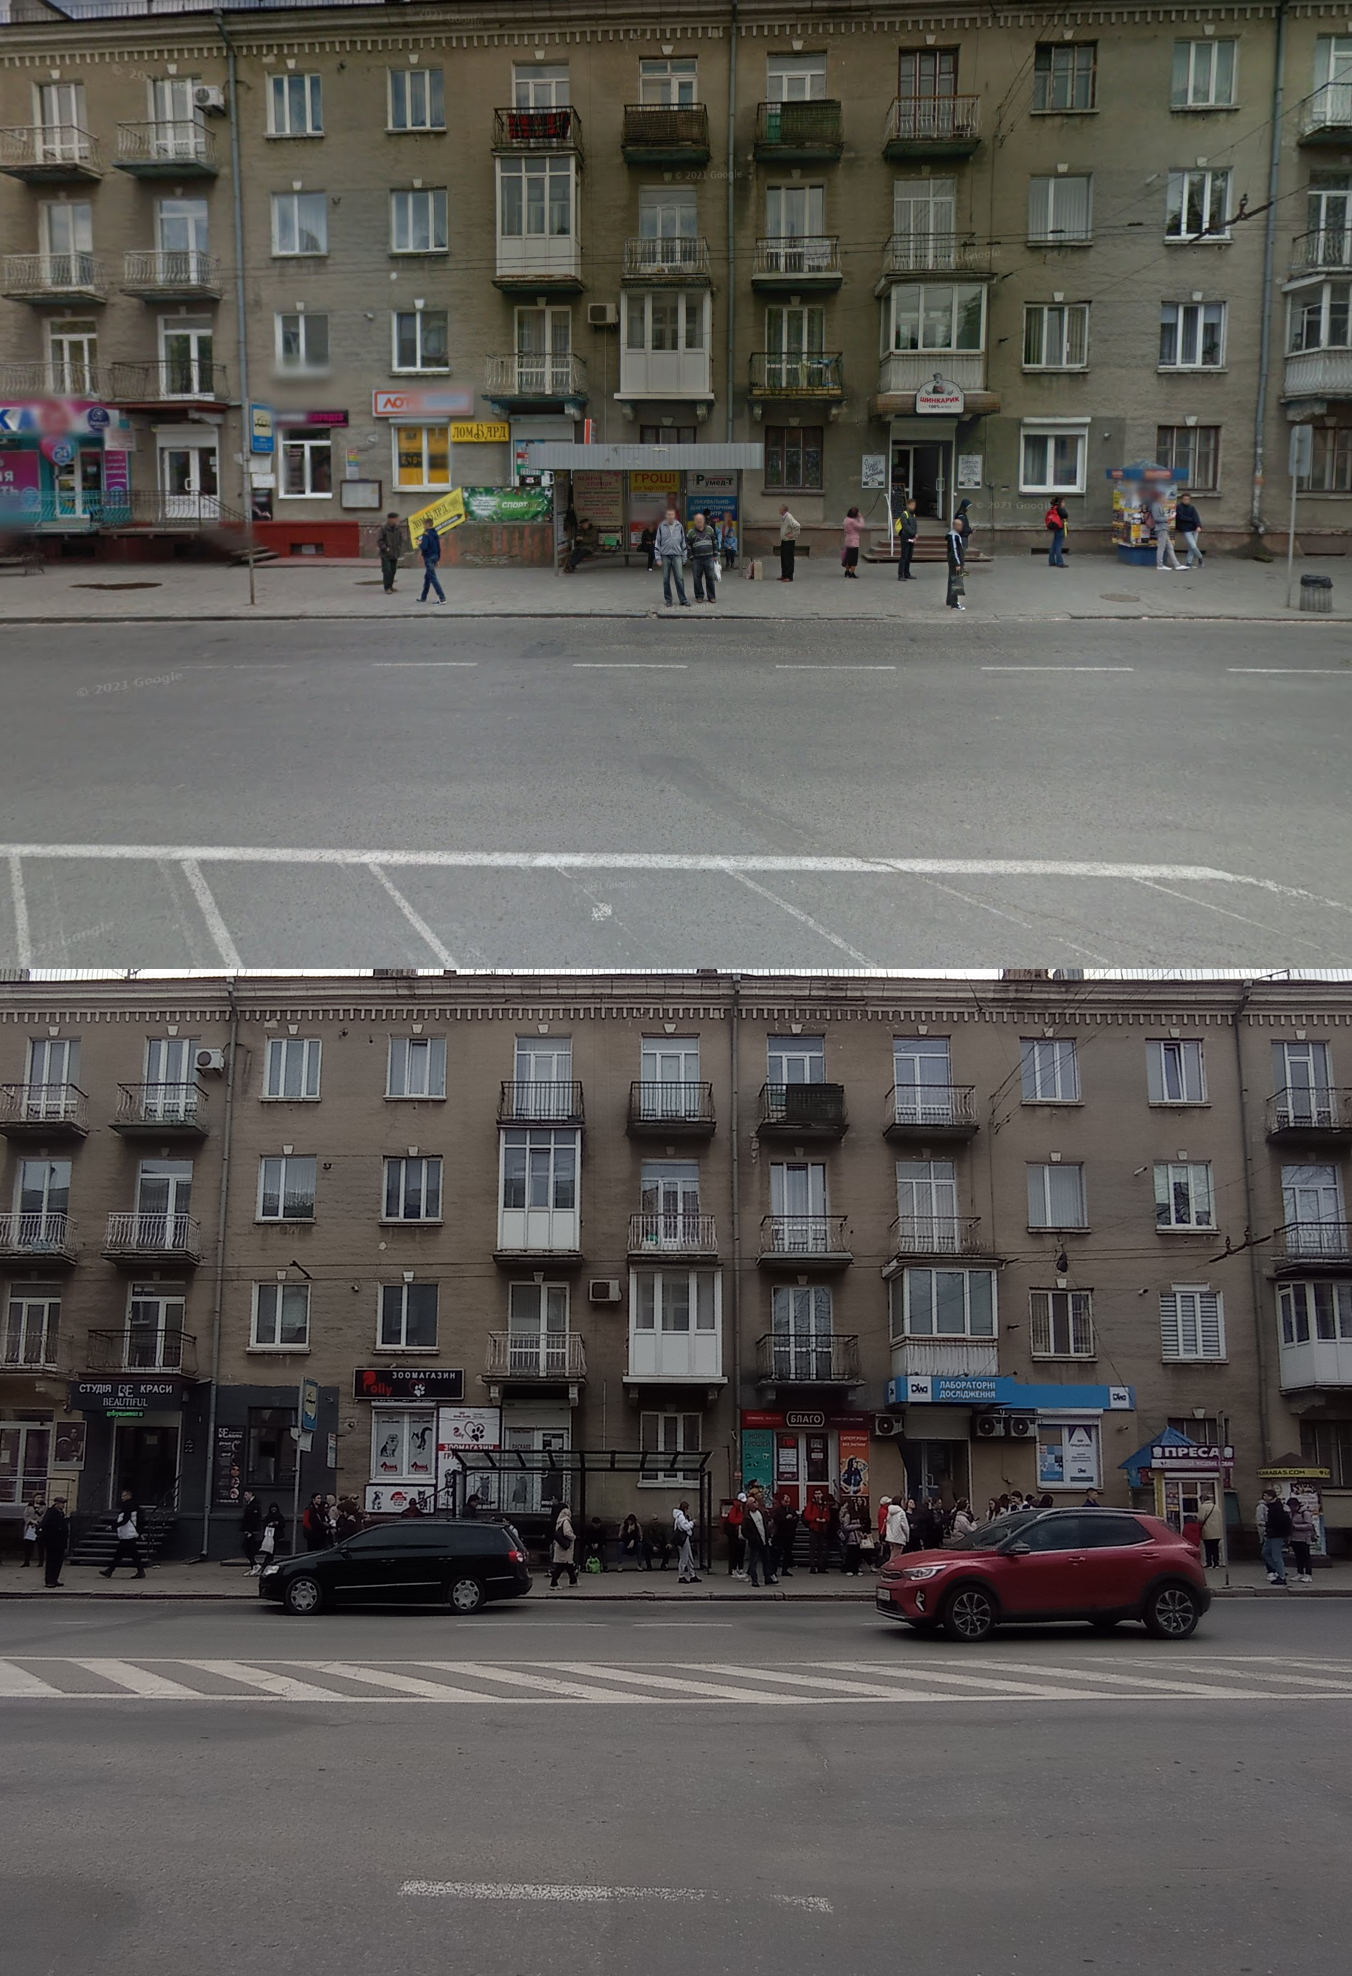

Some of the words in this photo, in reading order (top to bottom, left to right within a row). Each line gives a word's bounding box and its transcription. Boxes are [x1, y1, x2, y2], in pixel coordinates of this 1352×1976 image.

[919, 396, 960, 404] ШИНКАРИК
[452, 423, 507, 440] ЛОМБАРД
[634, 473, 676, 483] ГРОШІ
[392, 1371, 456, 1379] ЗООМАГАЗИН
[362, 1370, 393, 1397] Polly
[939, 1380, 996, 1389] ЛАБОРАТОРНІ
[79, 1384, 112, 1395] СТУДІЯ
[140, 1384, 173, 1394] КРАСИ
[939, 1390, 996, 1399] ДОСЛІДЖЕННЯ
[102, 1397, 148, 1407] BEAUTIFUL
[790, 1414, 821, 1424] БЛАГО
[1164, 1447, 1220, 1458] ПРЕСА
